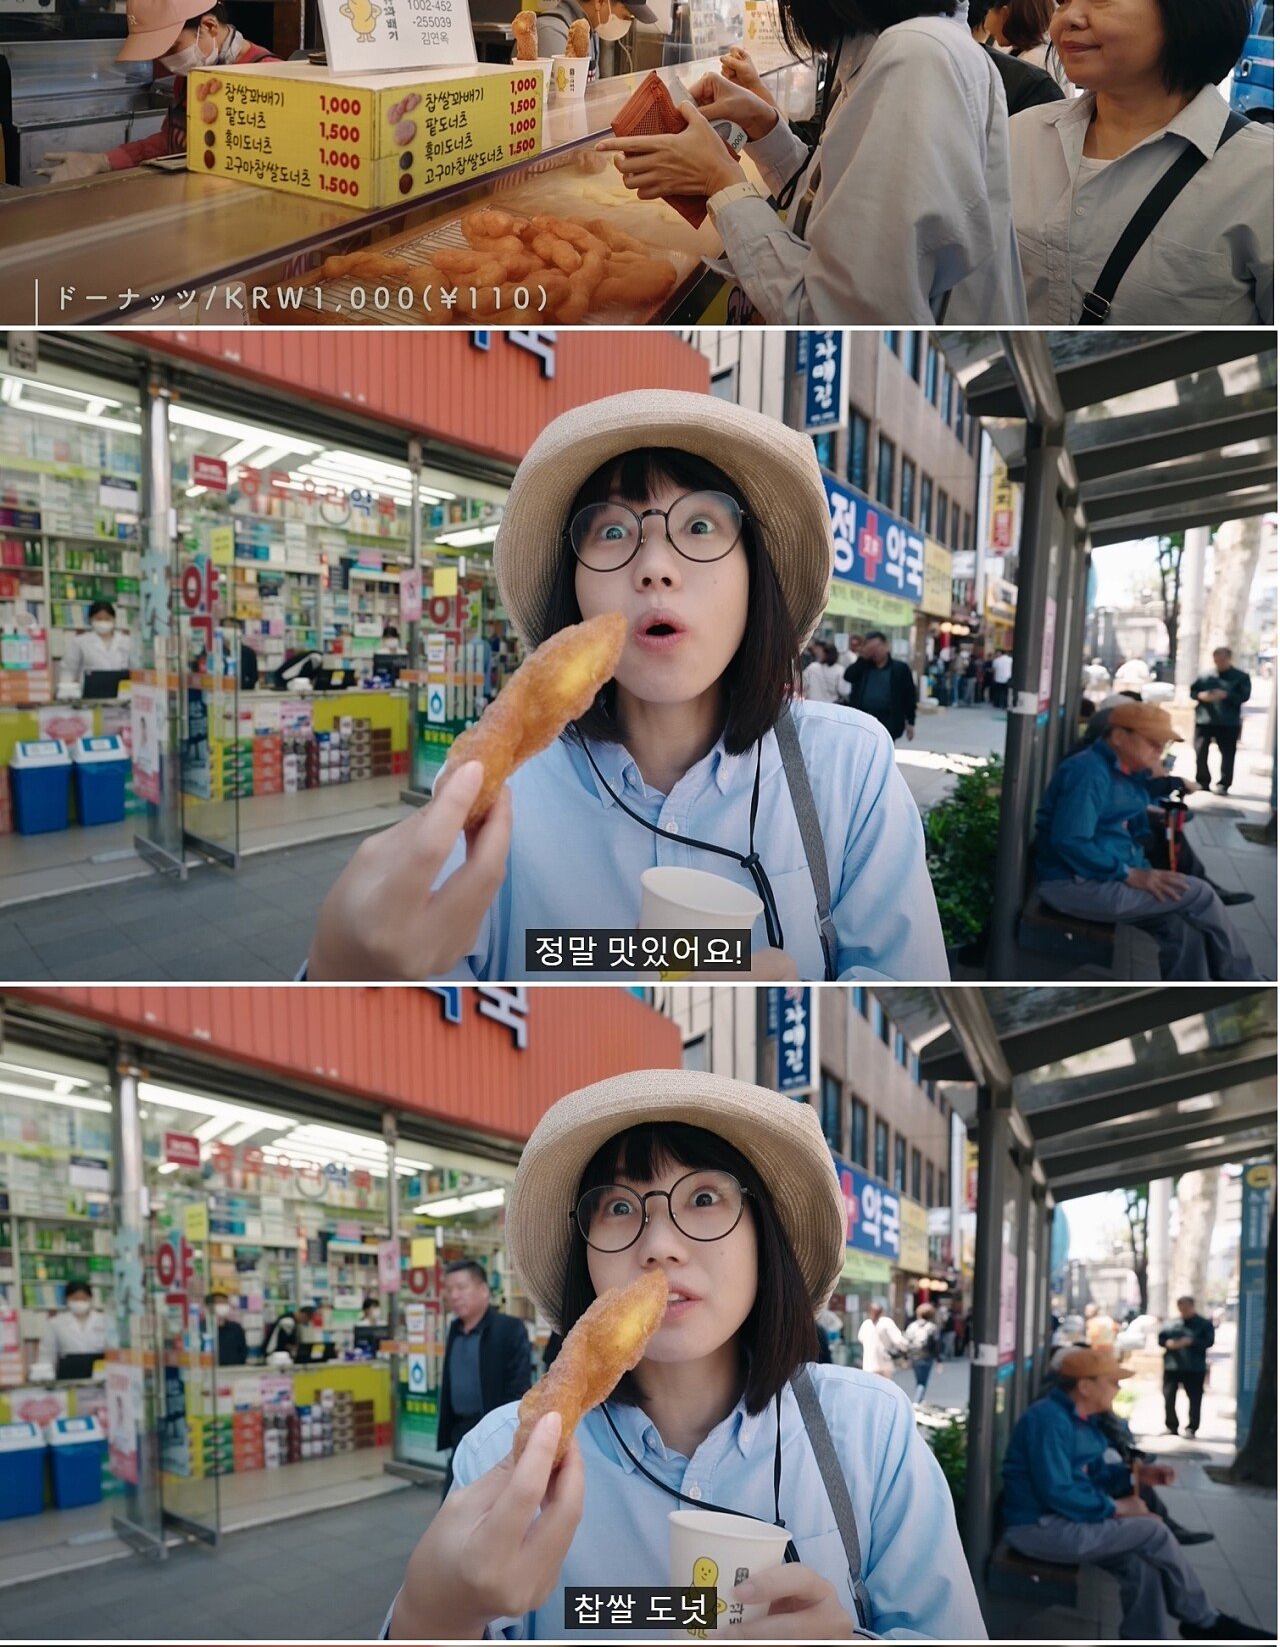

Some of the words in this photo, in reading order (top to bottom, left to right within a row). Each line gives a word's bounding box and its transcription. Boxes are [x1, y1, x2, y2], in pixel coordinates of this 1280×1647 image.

[412, 15, 452, 29] -255039
[420, 31, 450, 46] 김연옥
[224, 82, 285, 108] 찹쌀꽈배기
[319, 94, 361, 116] 1,000
[425, 88, 485, 113] 찹쌀꽈배기
[510, 77, 537, 95] 1,000
[225, 107, 267, 129] 팥도너츠
[319, 121, 360, 143] 1,500
[425, 111, 469, 136] 팥도너츠
[509, 97, 537, 115] 1,500
[224, 129, 273, 154] 흑미도너츠
[319, 148, 360, 171] 1,000
[425, 131, 474, 159] 흑미도너츠
[509, 117, 536, 136] 1,000
[224, 155, 311, 187] 고구마찹쌀도너츠
[424, 146, 504, 185] 고구마찹쌀도너츠
[885, 523, 924, 598] 약국
[861, 1183, 899, 1253] 약국
